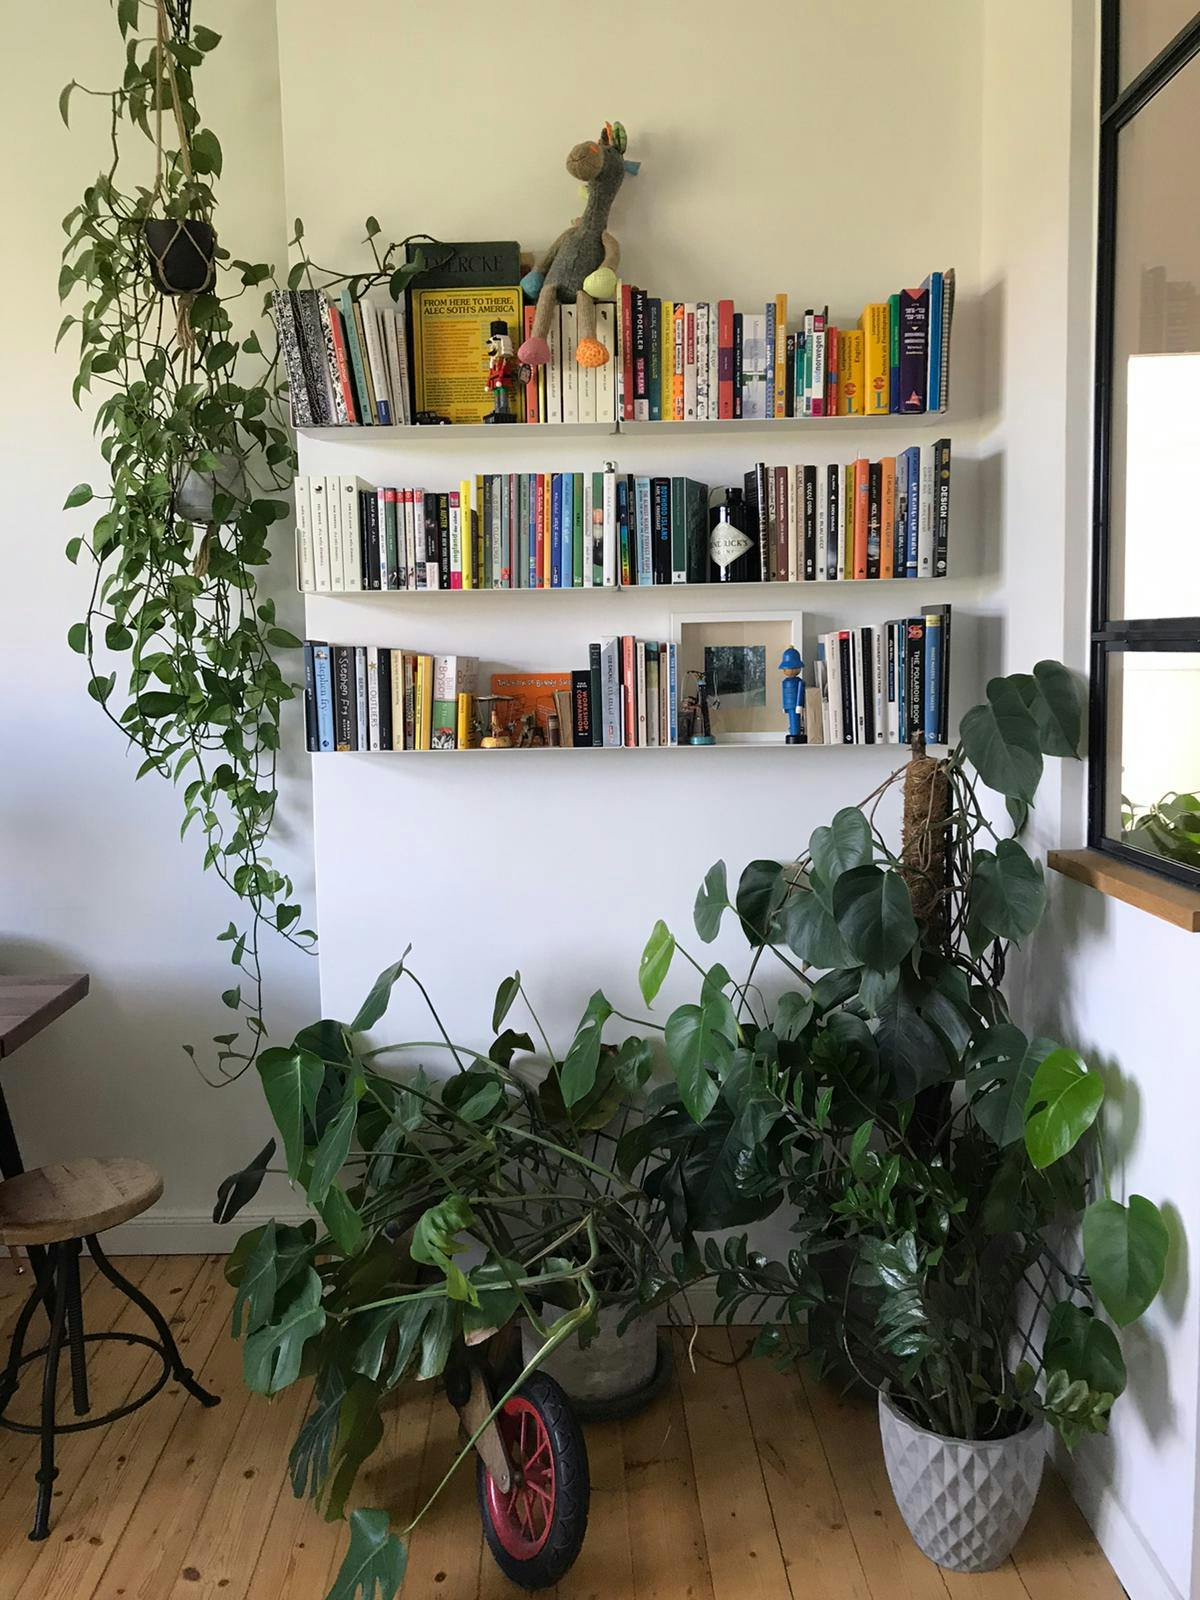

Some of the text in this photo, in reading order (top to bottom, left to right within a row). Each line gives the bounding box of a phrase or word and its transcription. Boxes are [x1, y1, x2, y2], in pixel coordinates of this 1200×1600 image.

[424, 305, 515, 315] ALEC SOTH'S AMERICA
[450, 298, 470, 306] HERE
[636, 314, 644, 350] POEHLER
[440, 510, 448, 528] AUSTER
[940, 486, 948, 518] DESIGN
[317, 662, 330, 712] stephen fry
[338, 658, 350, 714] Stephen Fry
[438, 666, 448, 700] Bryson
[370, 690, 378, 728] OUTLIERS
